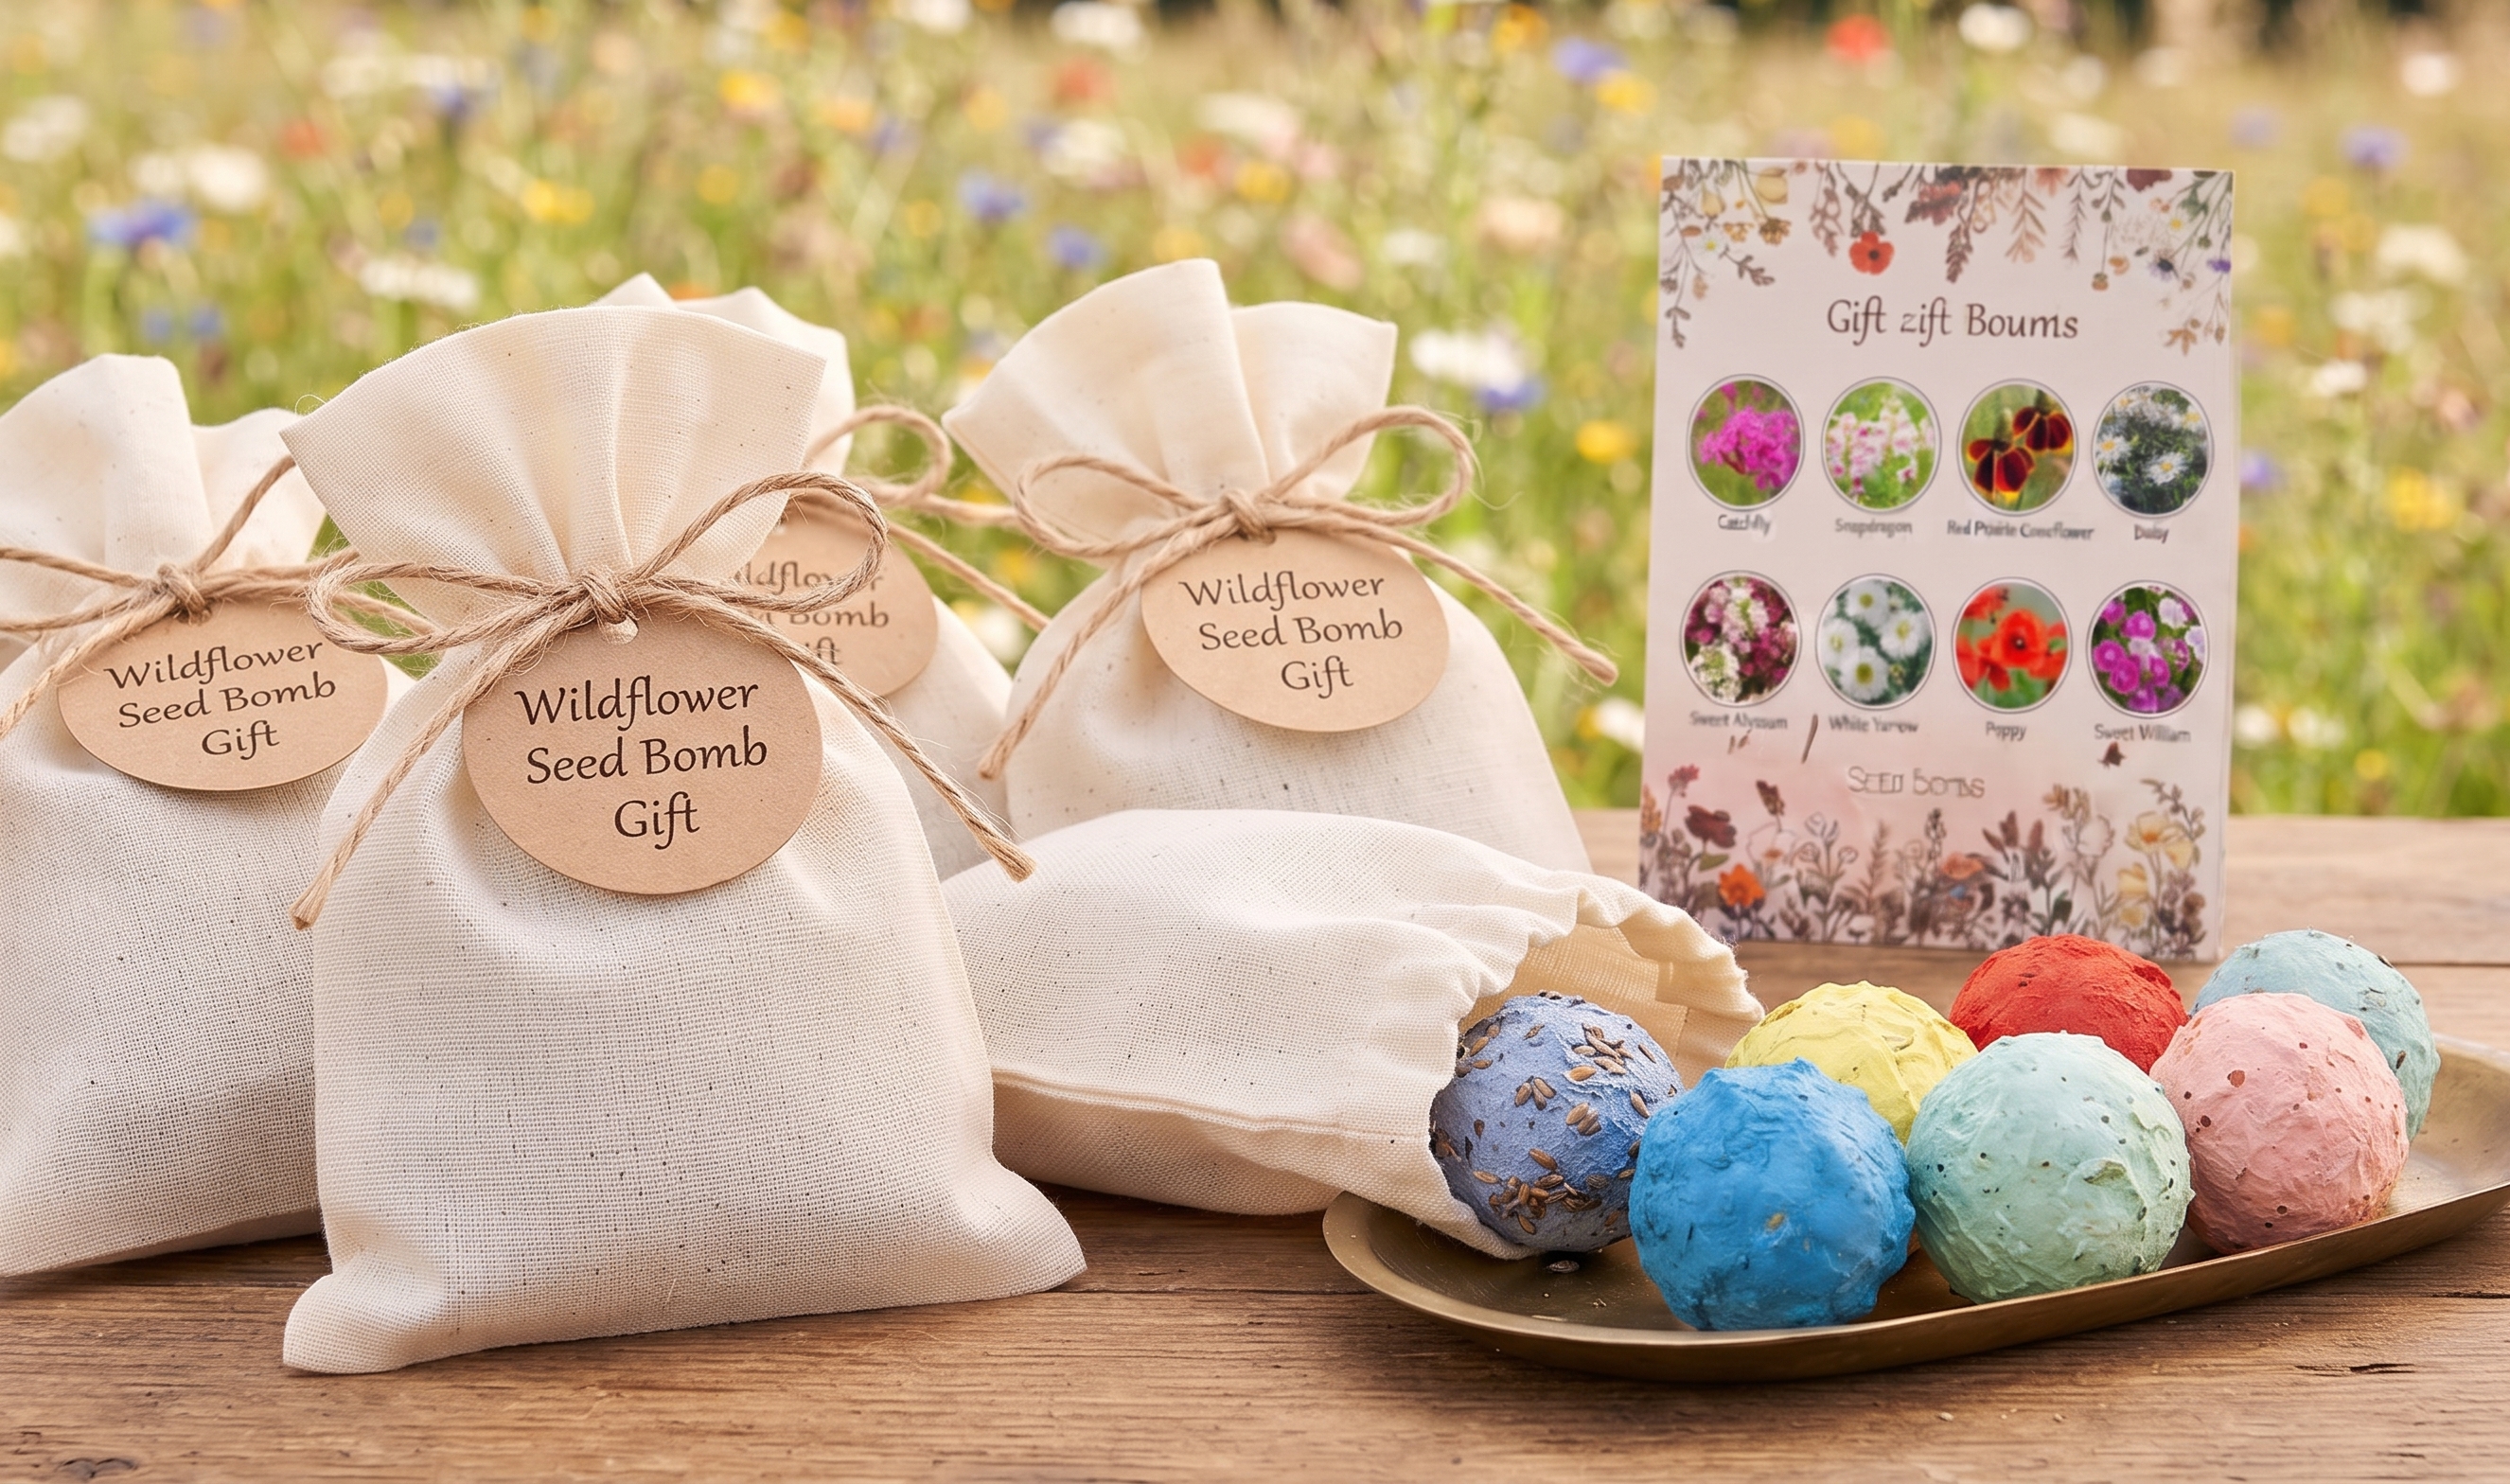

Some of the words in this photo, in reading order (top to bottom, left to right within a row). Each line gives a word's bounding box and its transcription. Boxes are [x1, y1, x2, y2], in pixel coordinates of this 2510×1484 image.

[1828, 295, 1886, 346] Gift
[1900, 296, 1952, 347] zift
[1178, 571, 1385, 611] Wildflower
[1198, 614, 1288, 650] Seed
[1292, 608, 1403, 645] Bomb
[103, 642, 323, 685] Wildflower
[1281, 655, 1353, 699] Gift
[118, 688, 211, 728] Seed
[219, 670, 336, 712] Bomb
[514, 675, 758, 732] Wildflower
[202, 720, 280, 760] Gift
[1986, 721, 2027, 742] Poppy
[527, 736, 628, 784] Seed
[640, 724, 768, 775] Bomb
[614, 791, 700, 850] Gift
